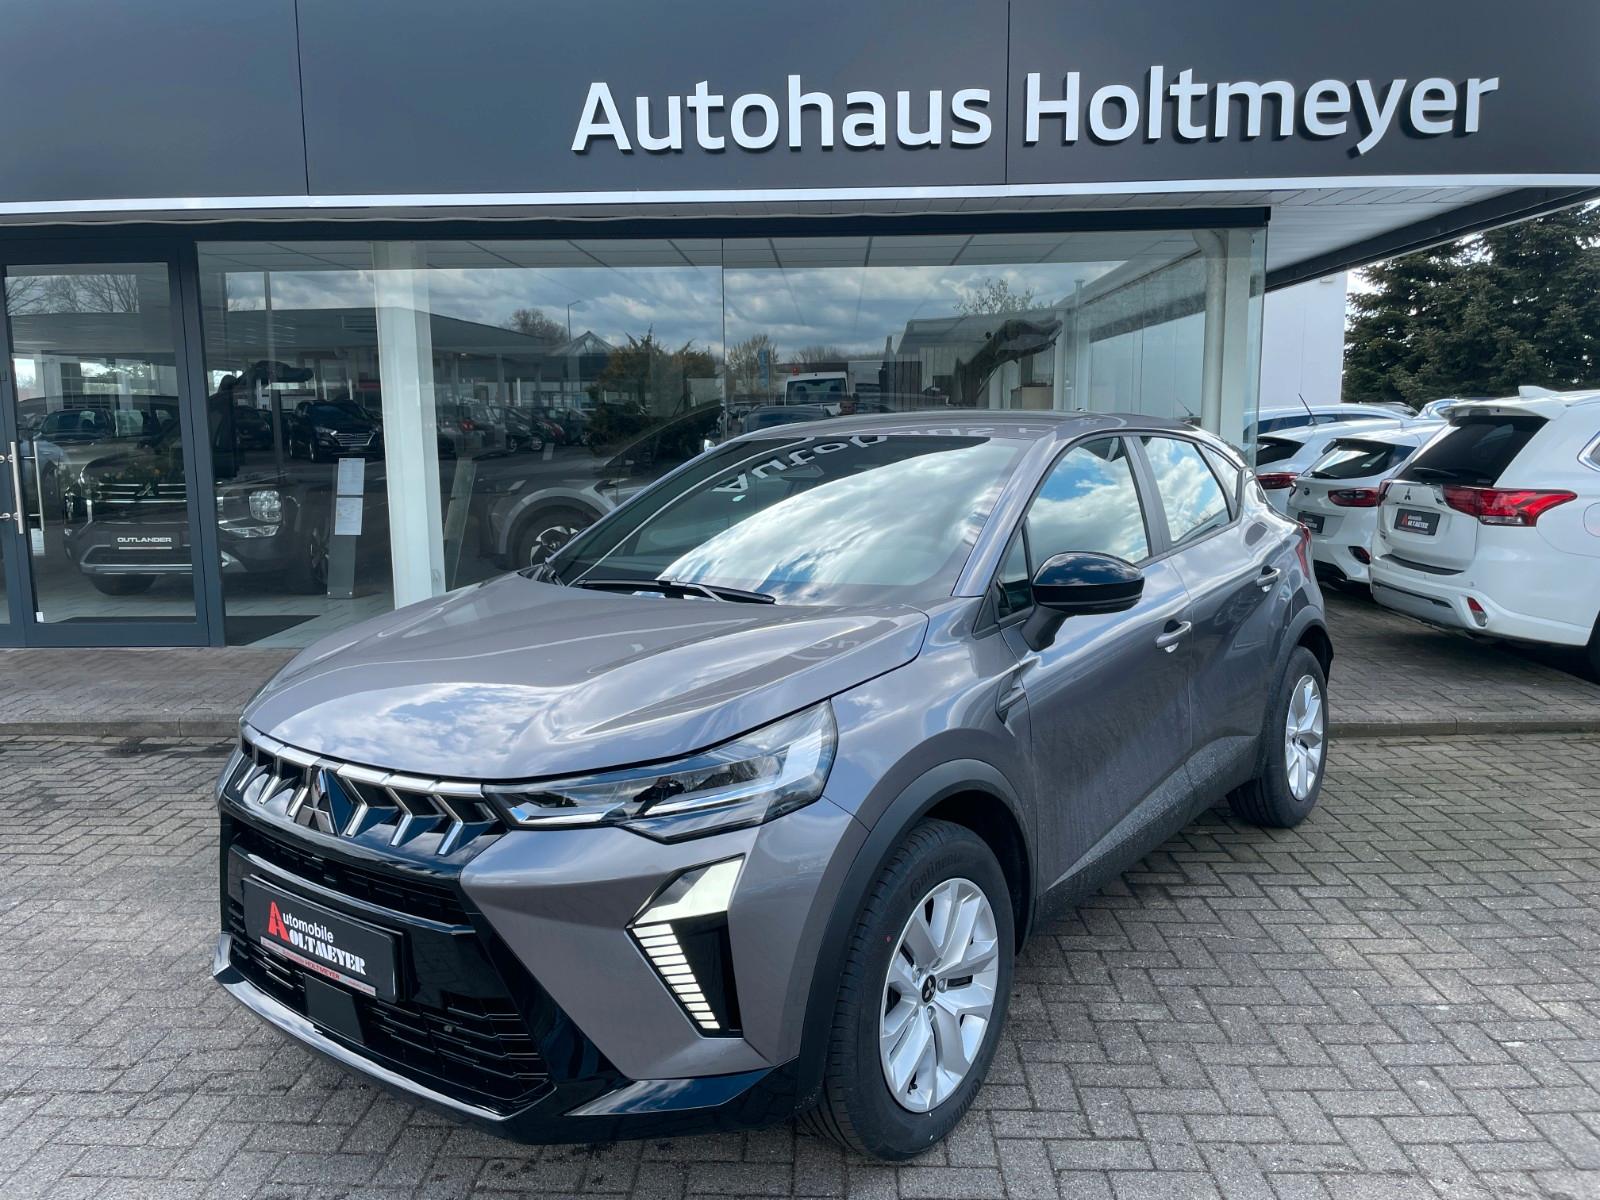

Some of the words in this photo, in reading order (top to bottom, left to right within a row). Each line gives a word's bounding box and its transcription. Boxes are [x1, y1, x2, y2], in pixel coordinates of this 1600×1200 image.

[571, 74, 993, 151] Autohaus
[1025, 65, 1499, 156] Holtmeyer
[268, 901, 334, 943] Automobile
